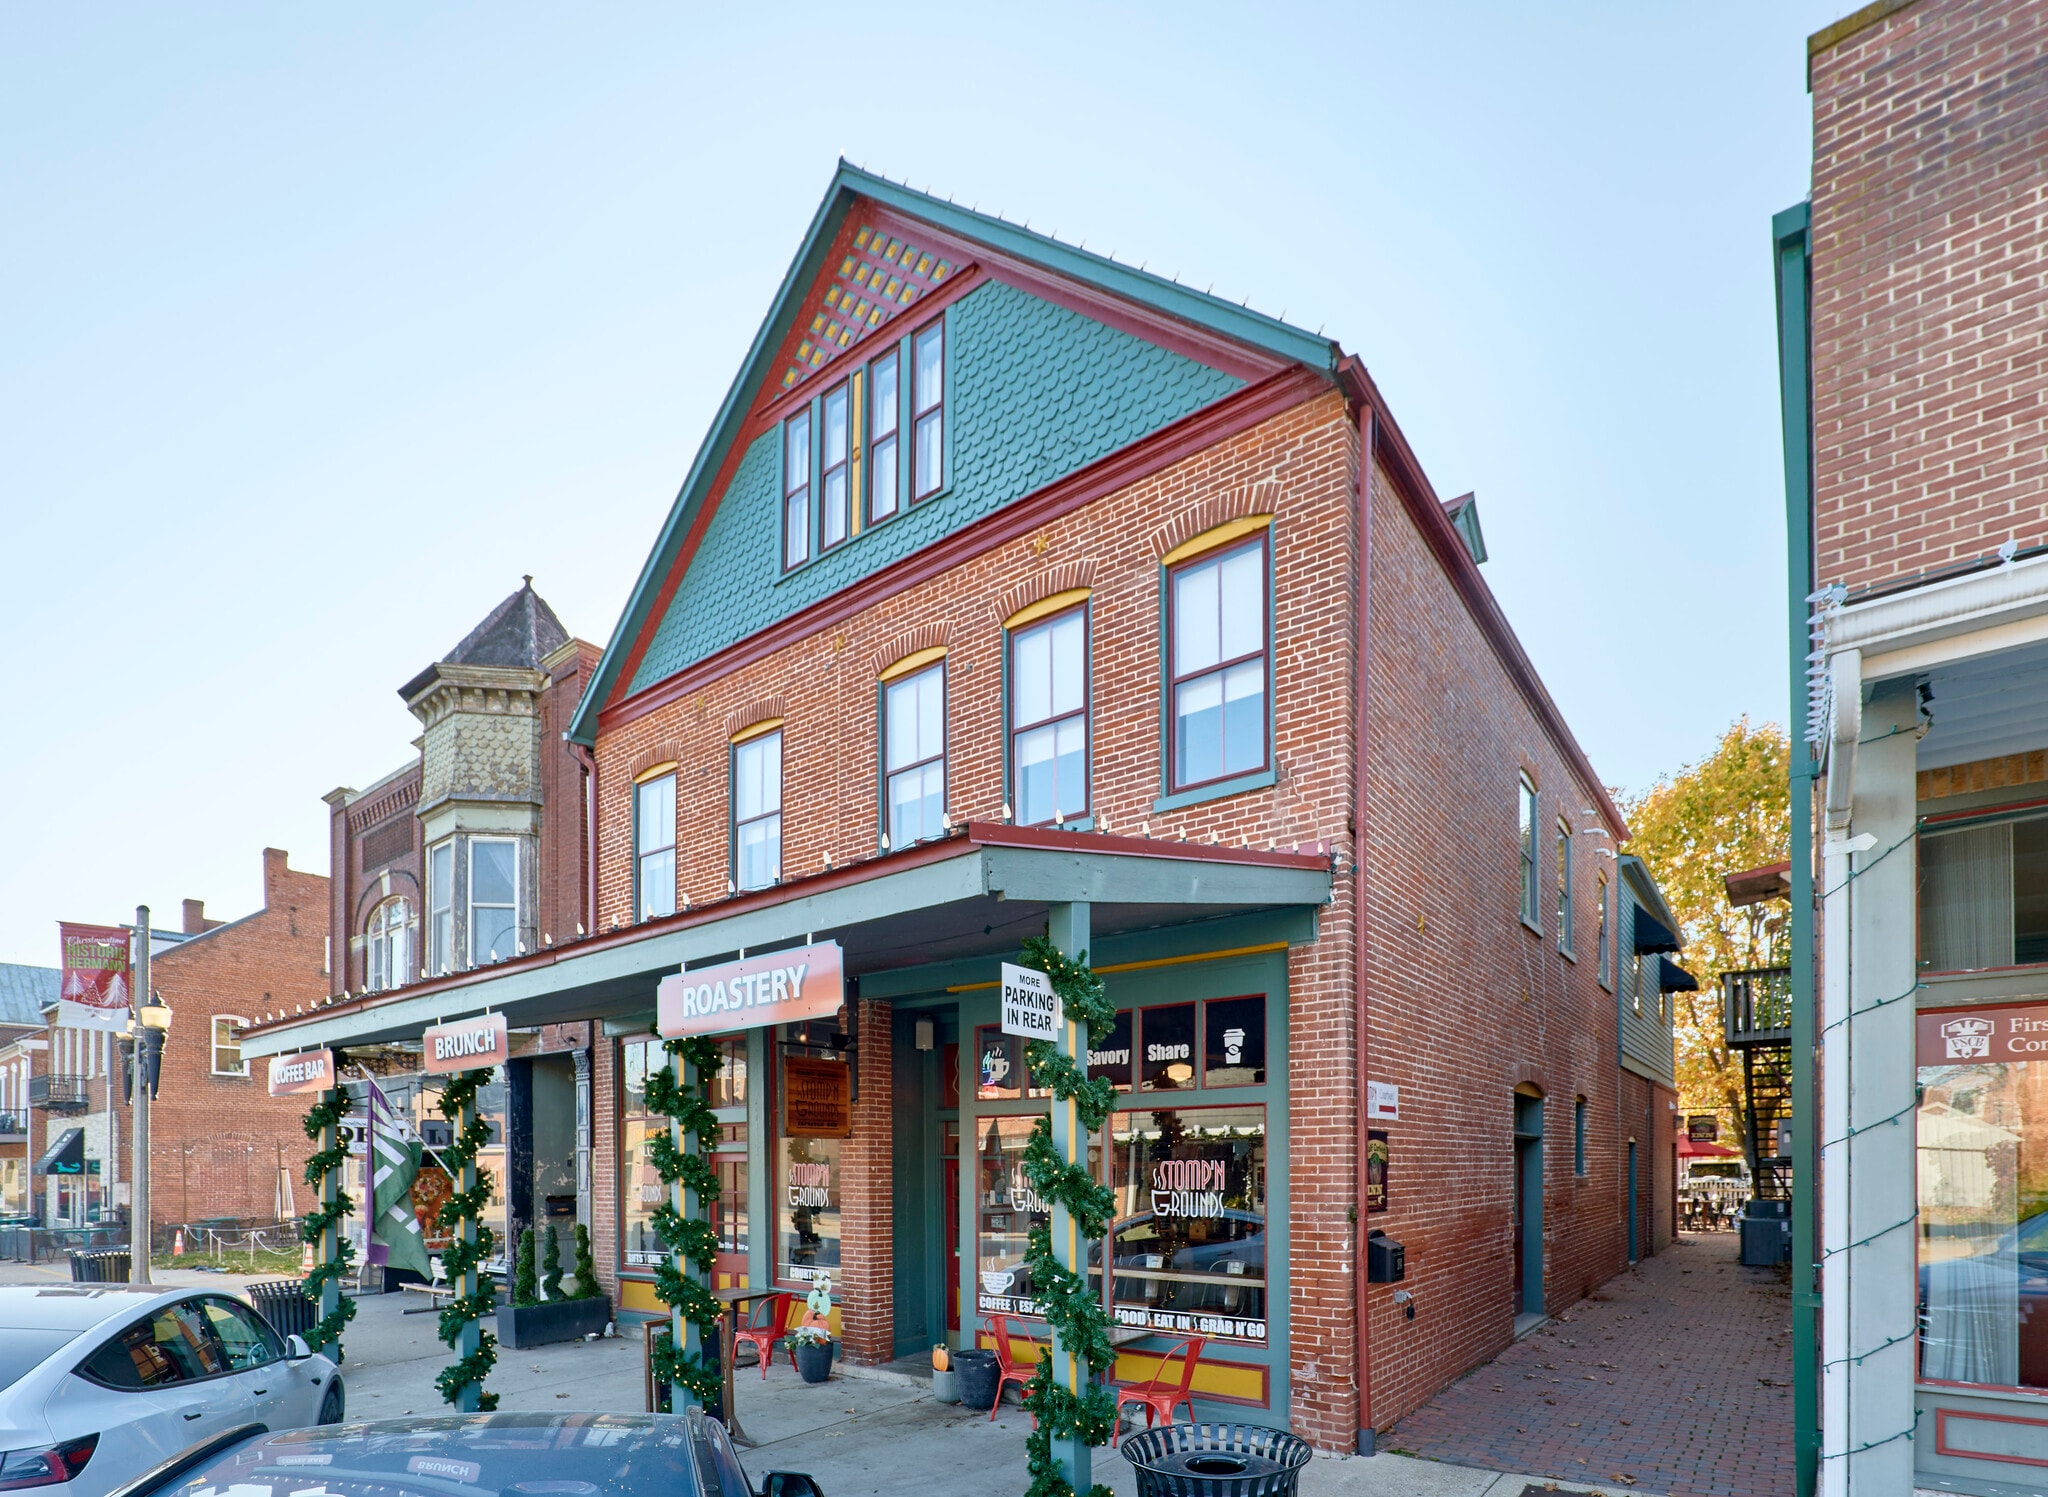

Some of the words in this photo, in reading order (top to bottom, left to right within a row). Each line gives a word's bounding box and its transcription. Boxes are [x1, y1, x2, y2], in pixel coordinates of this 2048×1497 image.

[66, 943, 126, 960] HISTORIC
[67, 957, 126, 972] HERMANN
[683, 963, 808, 1018] ROASTERY
[1019, 974, 1041, 988] MORE
[1005, 985, 1054, 1012] PARKING
[1007, 1007, 1019, 1026] IN
[1023, 1011, 1052, 1032] REAR
[435, 1027, 496, 1061] BRUNCH
[1087, 1048, 1130, 1067] Savory
[1147, 1043, 1190, 1062] Share
[1951, 1036, 1985, 1050] FSCB
[275, 1062, 305, 1085] COFFEE
[304, 1058, 326, 1081] BAR
[791, 1163, 830, 1187] STOMP'N
[1159, 1159, 1226, 1191] STOMP'N
[788, 1186, 829, 1208] GROUNDS
[1010, 1187, 1049, 1213] GROU
[1151, 1189, 1225, 1219] GROUNDS
[979, 1295, 1011, 1310] COFFEE
[1114, 1309, 1146, 1325] FOOD
[1153, 1312, 1176, 1329] EAT
[1176, 1314, 1190, 1331] IN
[1199, 1317, 1235, 1335] GRAB
